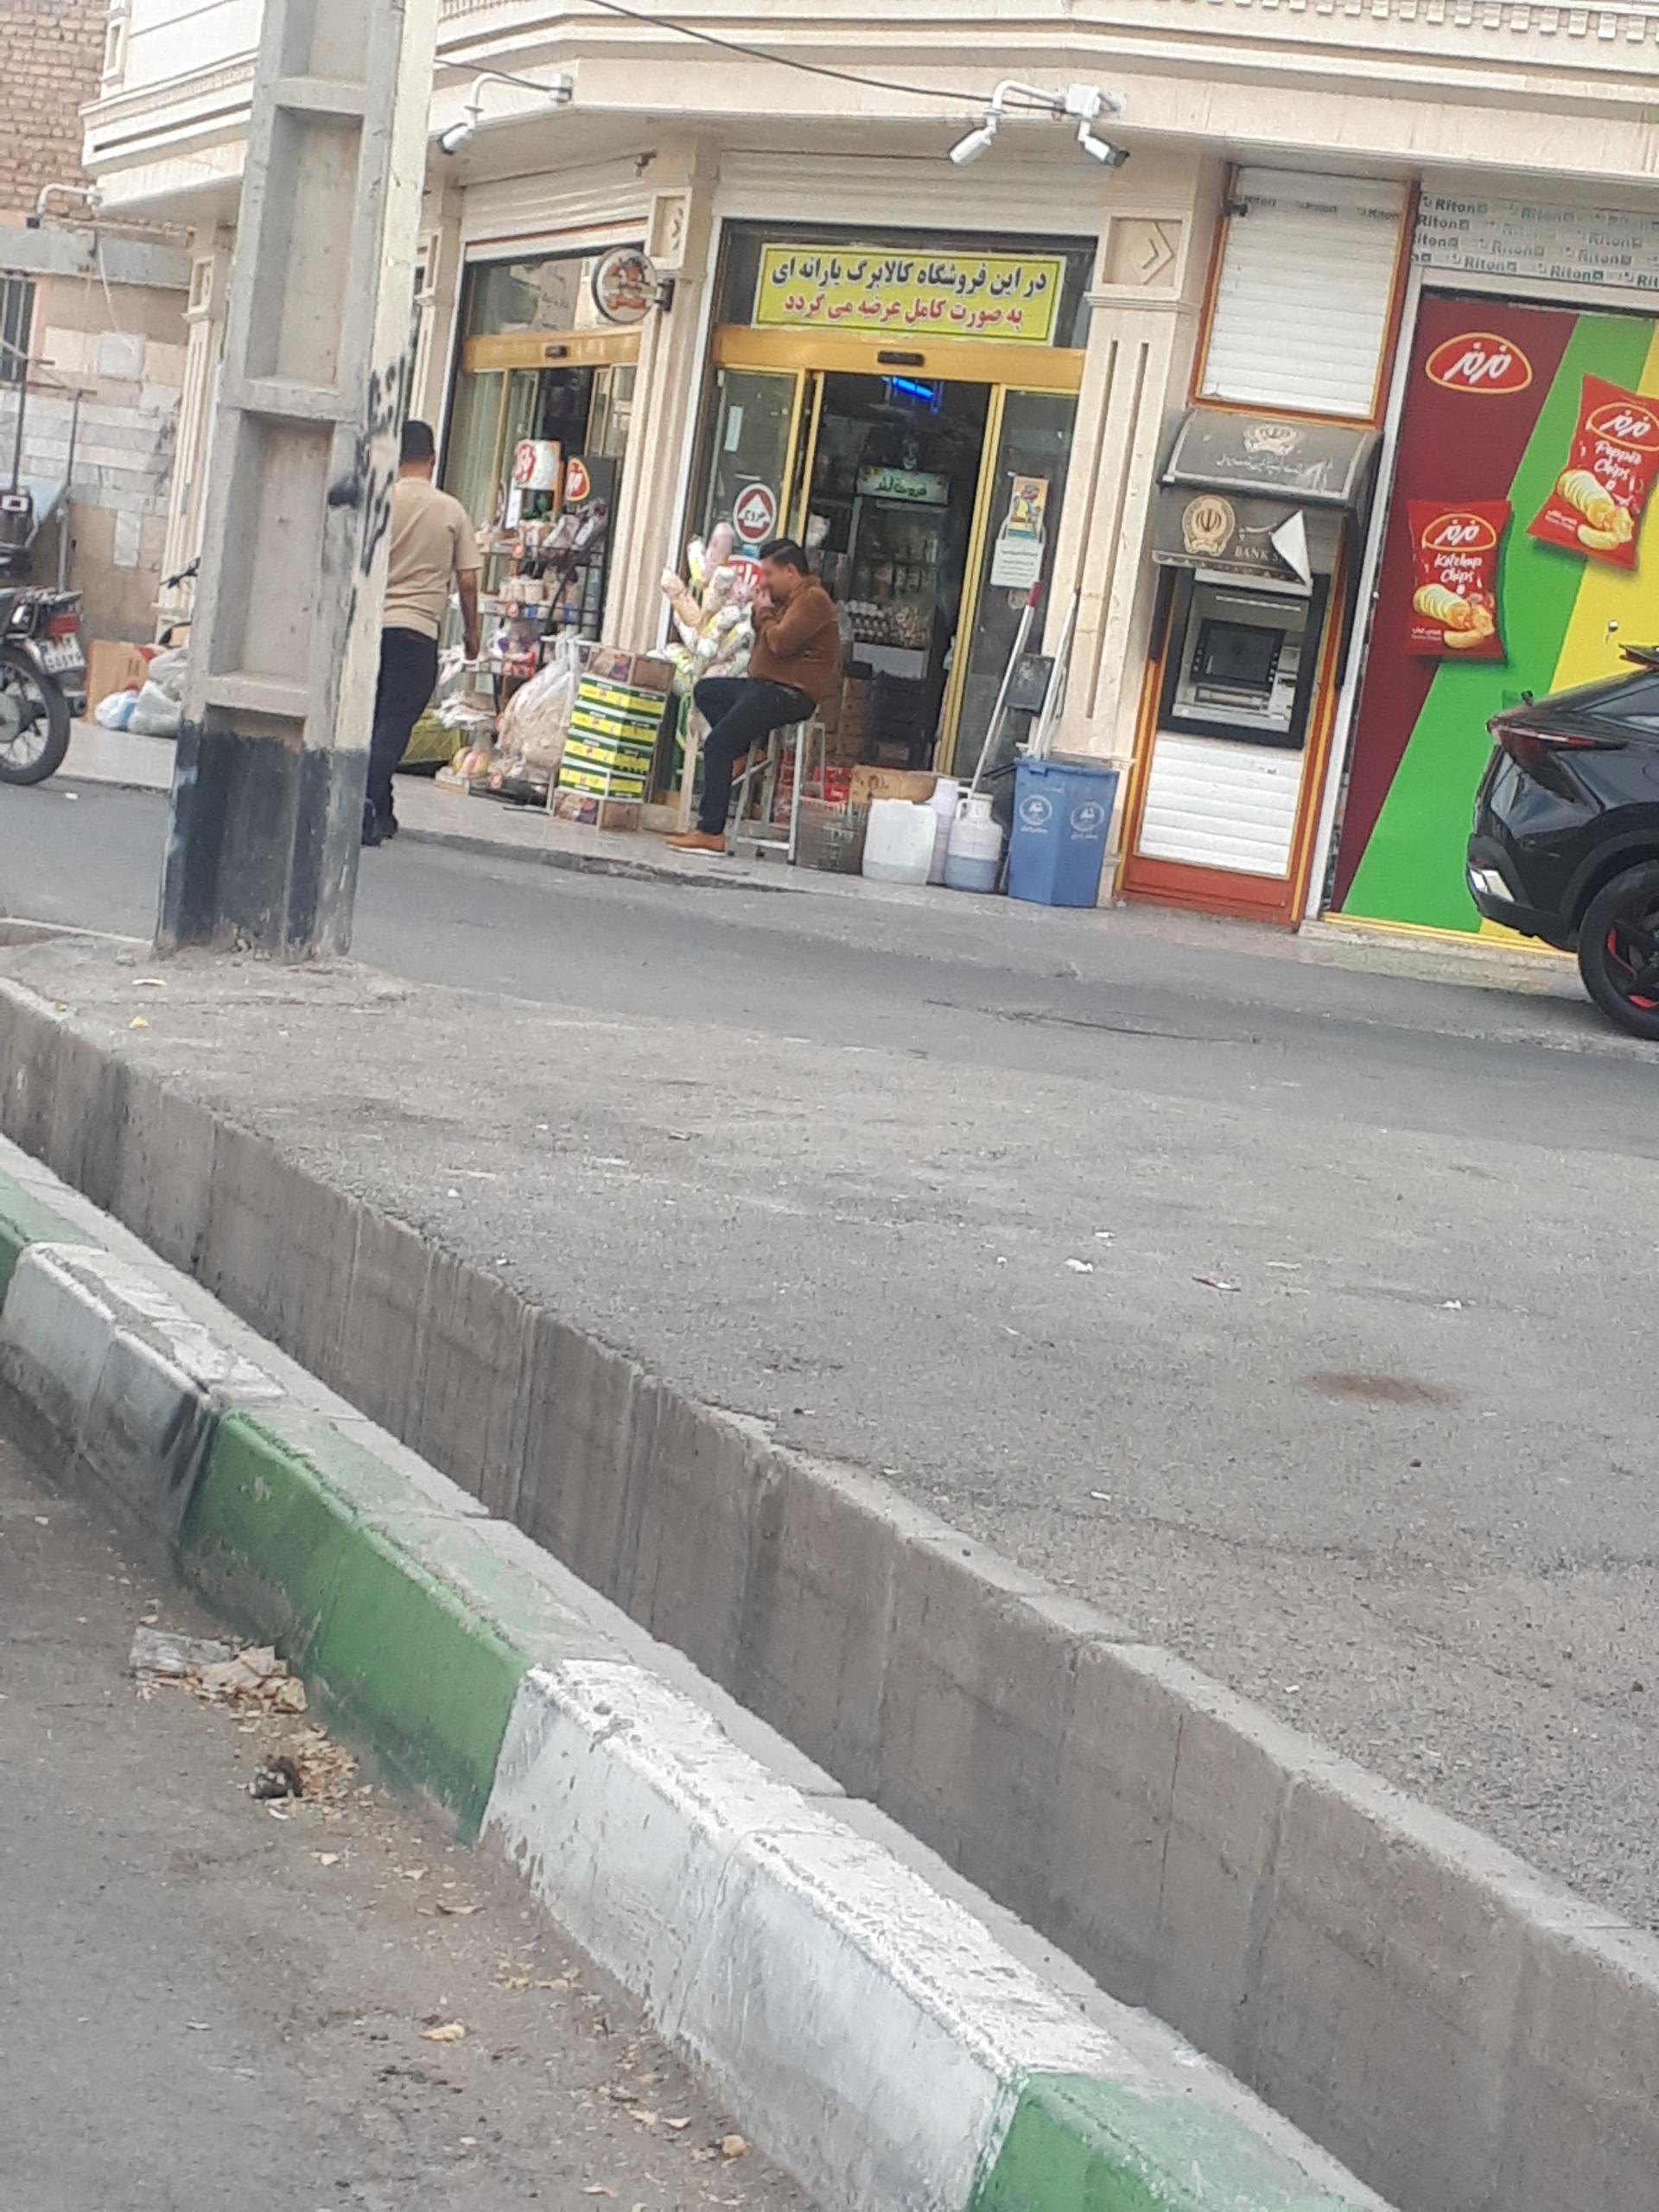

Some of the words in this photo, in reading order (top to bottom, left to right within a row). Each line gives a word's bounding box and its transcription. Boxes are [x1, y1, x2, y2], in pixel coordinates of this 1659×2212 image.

[1414, 235, 1448, 248] iton
[799, 257, 842, 288] یارانه
[917, 262, 987, 295] فروشگاه
[990, 267, 1021, 296] این
[1023, 272, 1047, 298] در
[784, 293, 825, 319] گردد
[828, 302, 854, 321] می
[858, 297, 900, 324] عرضه
[905, 297, 946, 324] کامل
[950, 302, 1002, 328] صورت
[1006, 308, 1023, 331] به
[1442, 342, 1512, 385] مزمز
[1599, 409, 1651, 438] مزمز
[1594, 459, 1630, 480] Chips
[1433, 519, 1480, 546] مزمز
[1234, 546, 1268, 561] BANK
[1434, 553, 1483, 570] Ketchup
[1440, 569, 1474, 584] Chips
